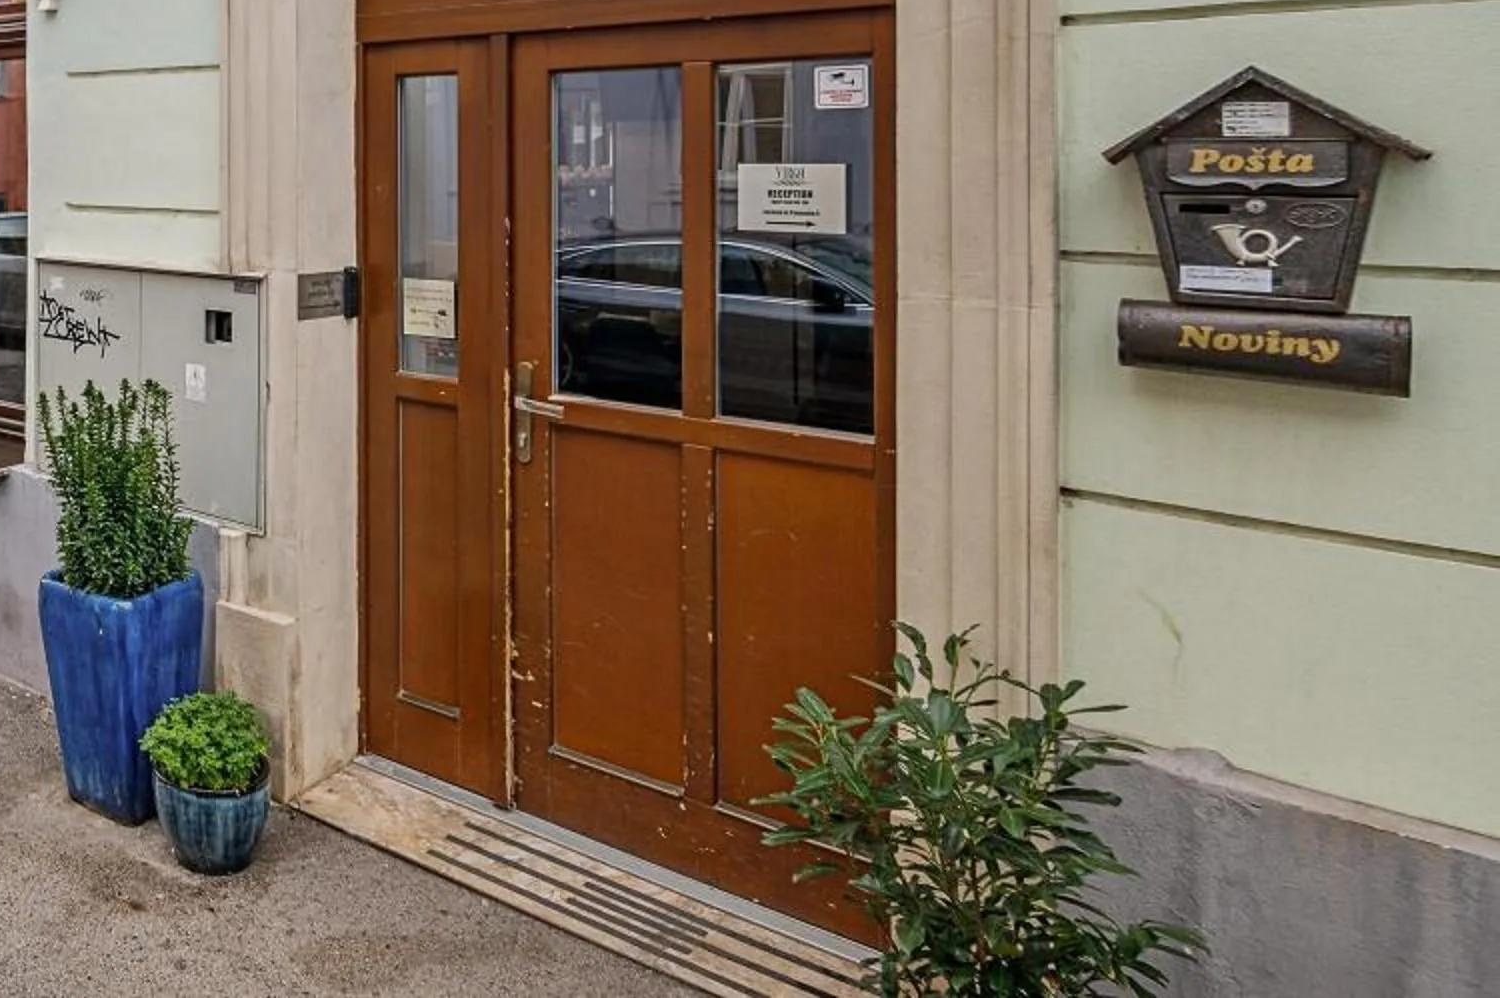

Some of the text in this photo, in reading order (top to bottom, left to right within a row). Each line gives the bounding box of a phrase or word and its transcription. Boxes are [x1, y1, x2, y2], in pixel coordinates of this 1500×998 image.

[1188, 145, 1315, 173] Pošta
[767, 189, 813, 199] RECEPTION
[1178, 324, 1341, 363] Noviny
